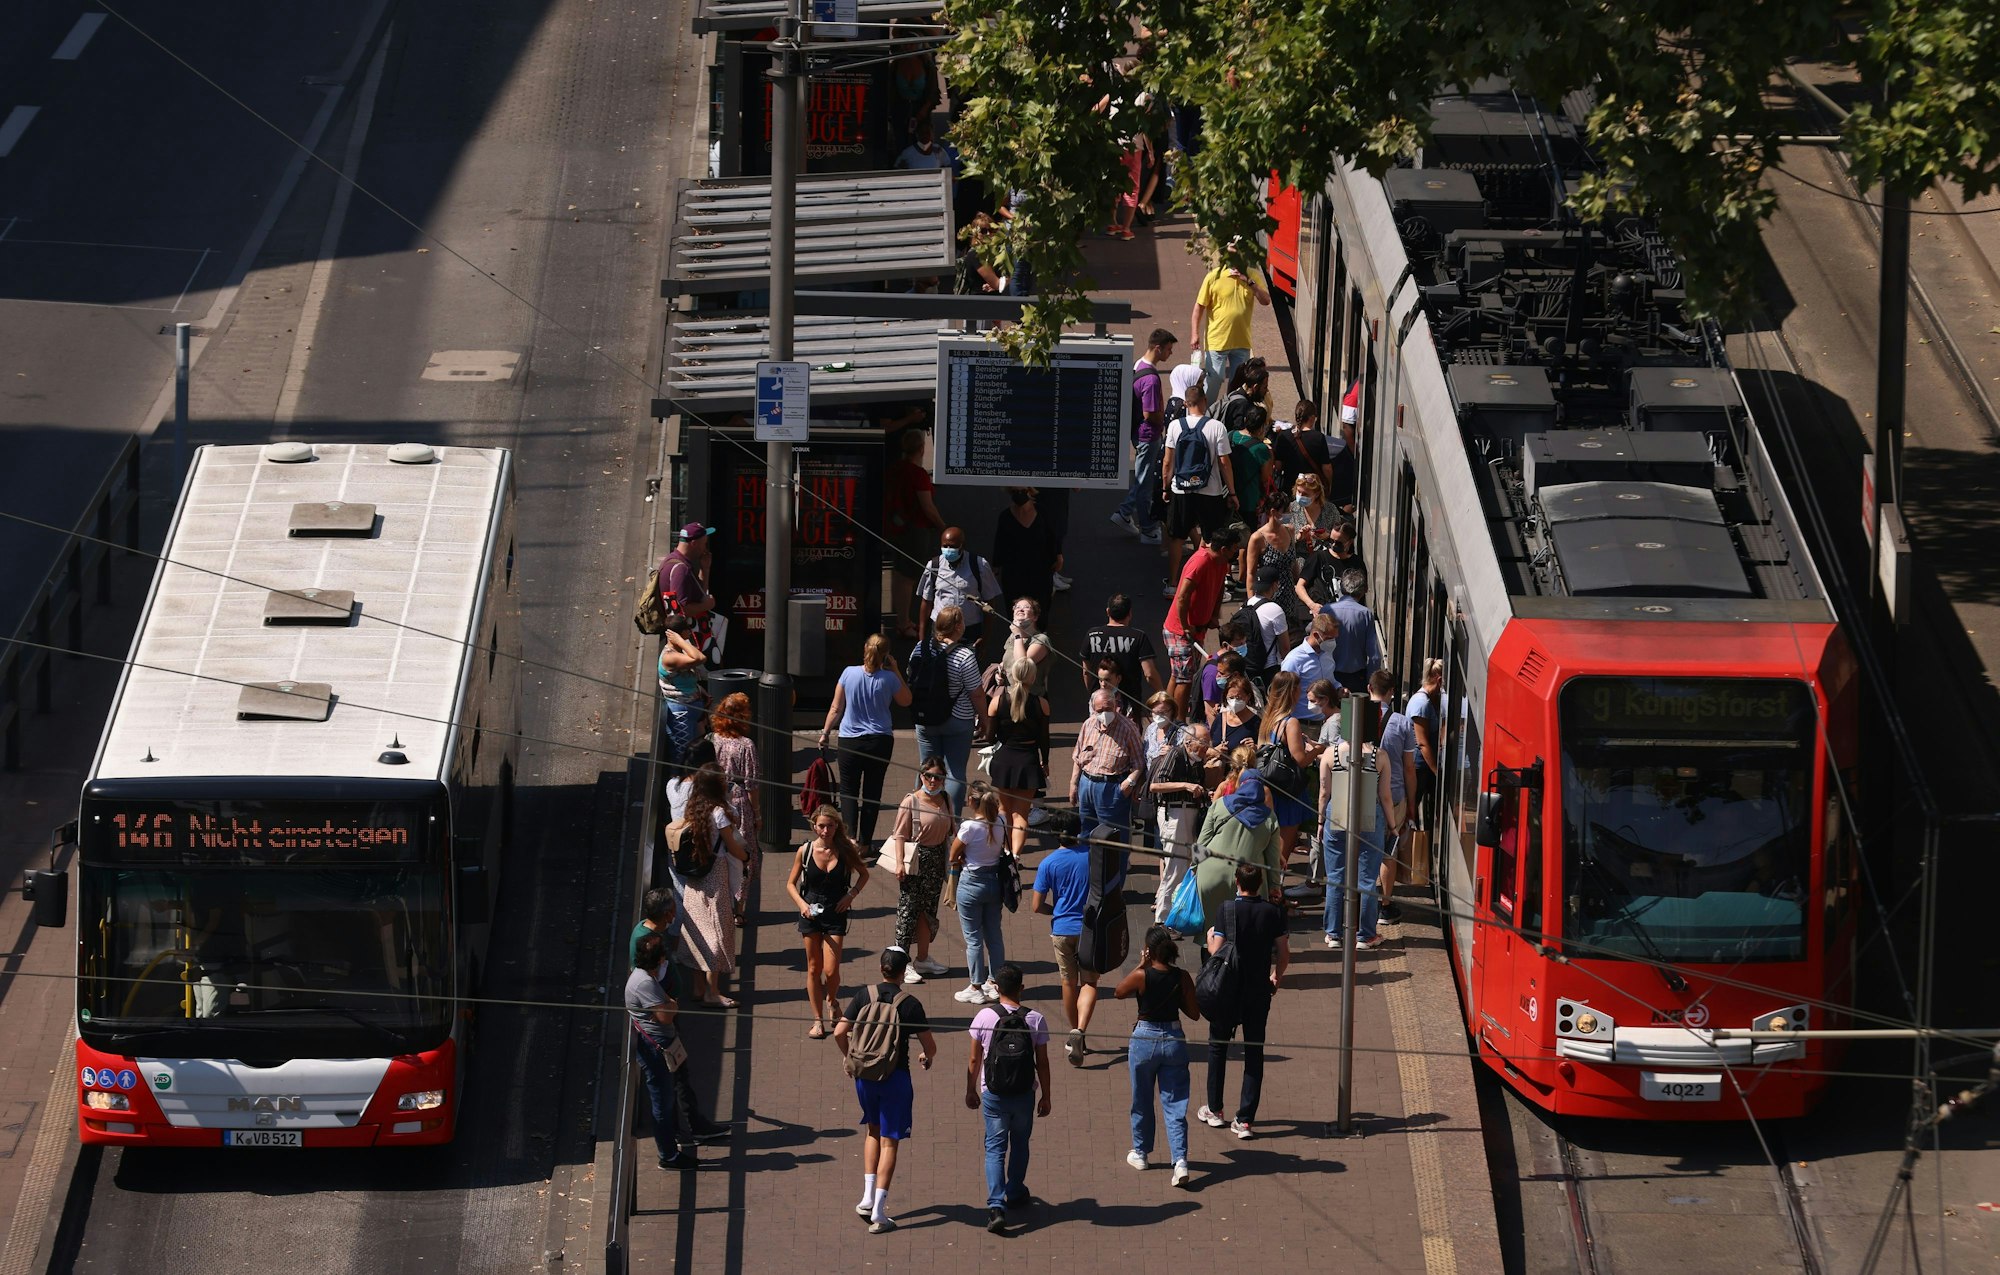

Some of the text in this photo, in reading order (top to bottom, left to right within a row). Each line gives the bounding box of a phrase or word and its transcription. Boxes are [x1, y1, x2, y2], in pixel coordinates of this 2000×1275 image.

[976, 366, 1007, 374] Bensberg
[974, 388, 1013, 396] Königsforst
[973, 432, 1006, 440] Bensberg
[973, 438, 1011, 446] Königsforst
[972, 453, 1004, 461] Bensberg
[733, 594, 762, 608] AB
[824, 616, 844, 630] ÖLN
[1090, 636, 1135, 653] RAW
[113, 813, 408, 850] 146 Nicht einsteigen
[1661, 1084, 1704, 1096] 4022
[228, 1096, 300, 1112] MAN
